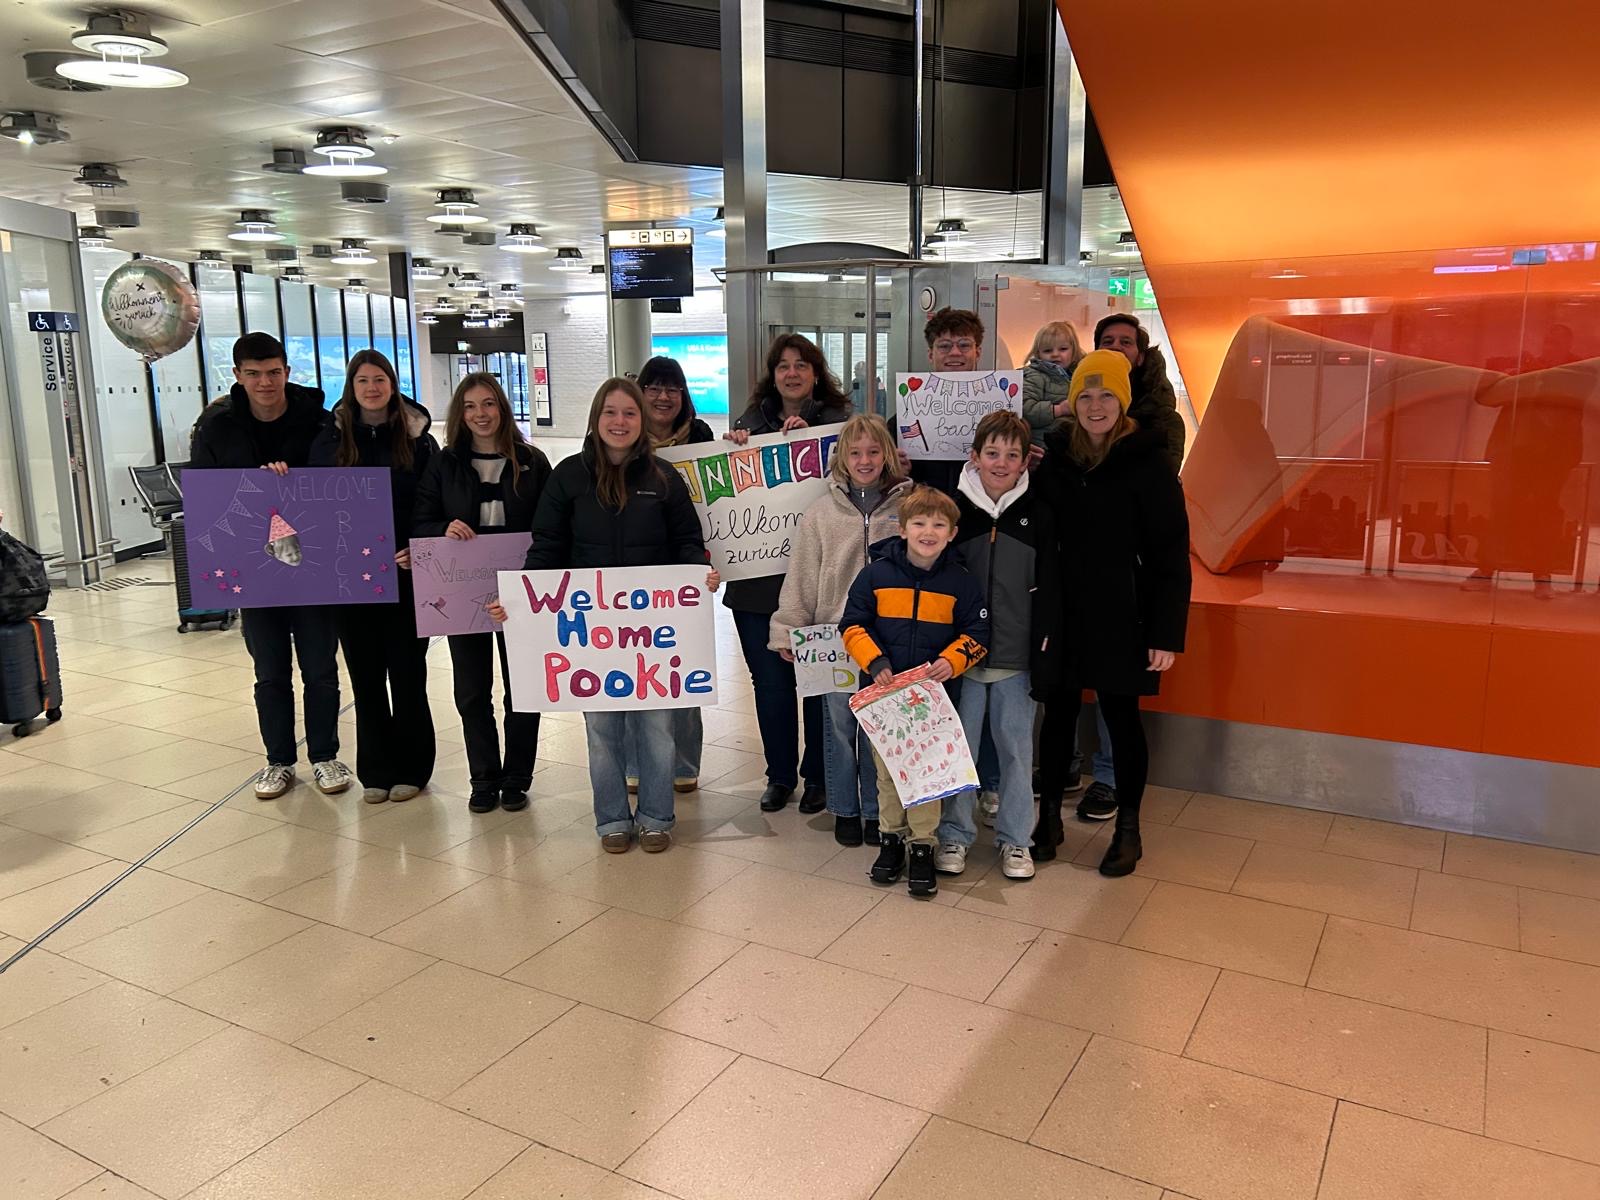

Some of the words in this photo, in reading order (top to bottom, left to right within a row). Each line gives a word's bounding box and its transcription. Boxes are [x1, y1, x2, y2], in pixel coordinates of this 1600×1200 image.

[42, 337, 57, 391] Service
[275, 474, 378, 502] WELCOME
[335, 510, 353, 598] BACK
[725, 537, 792, 565] zurück
[521, 570, 701, 613] Welcome
[557, 609, 677, 650] Home
[544, 652, 713, 703] Pookie
